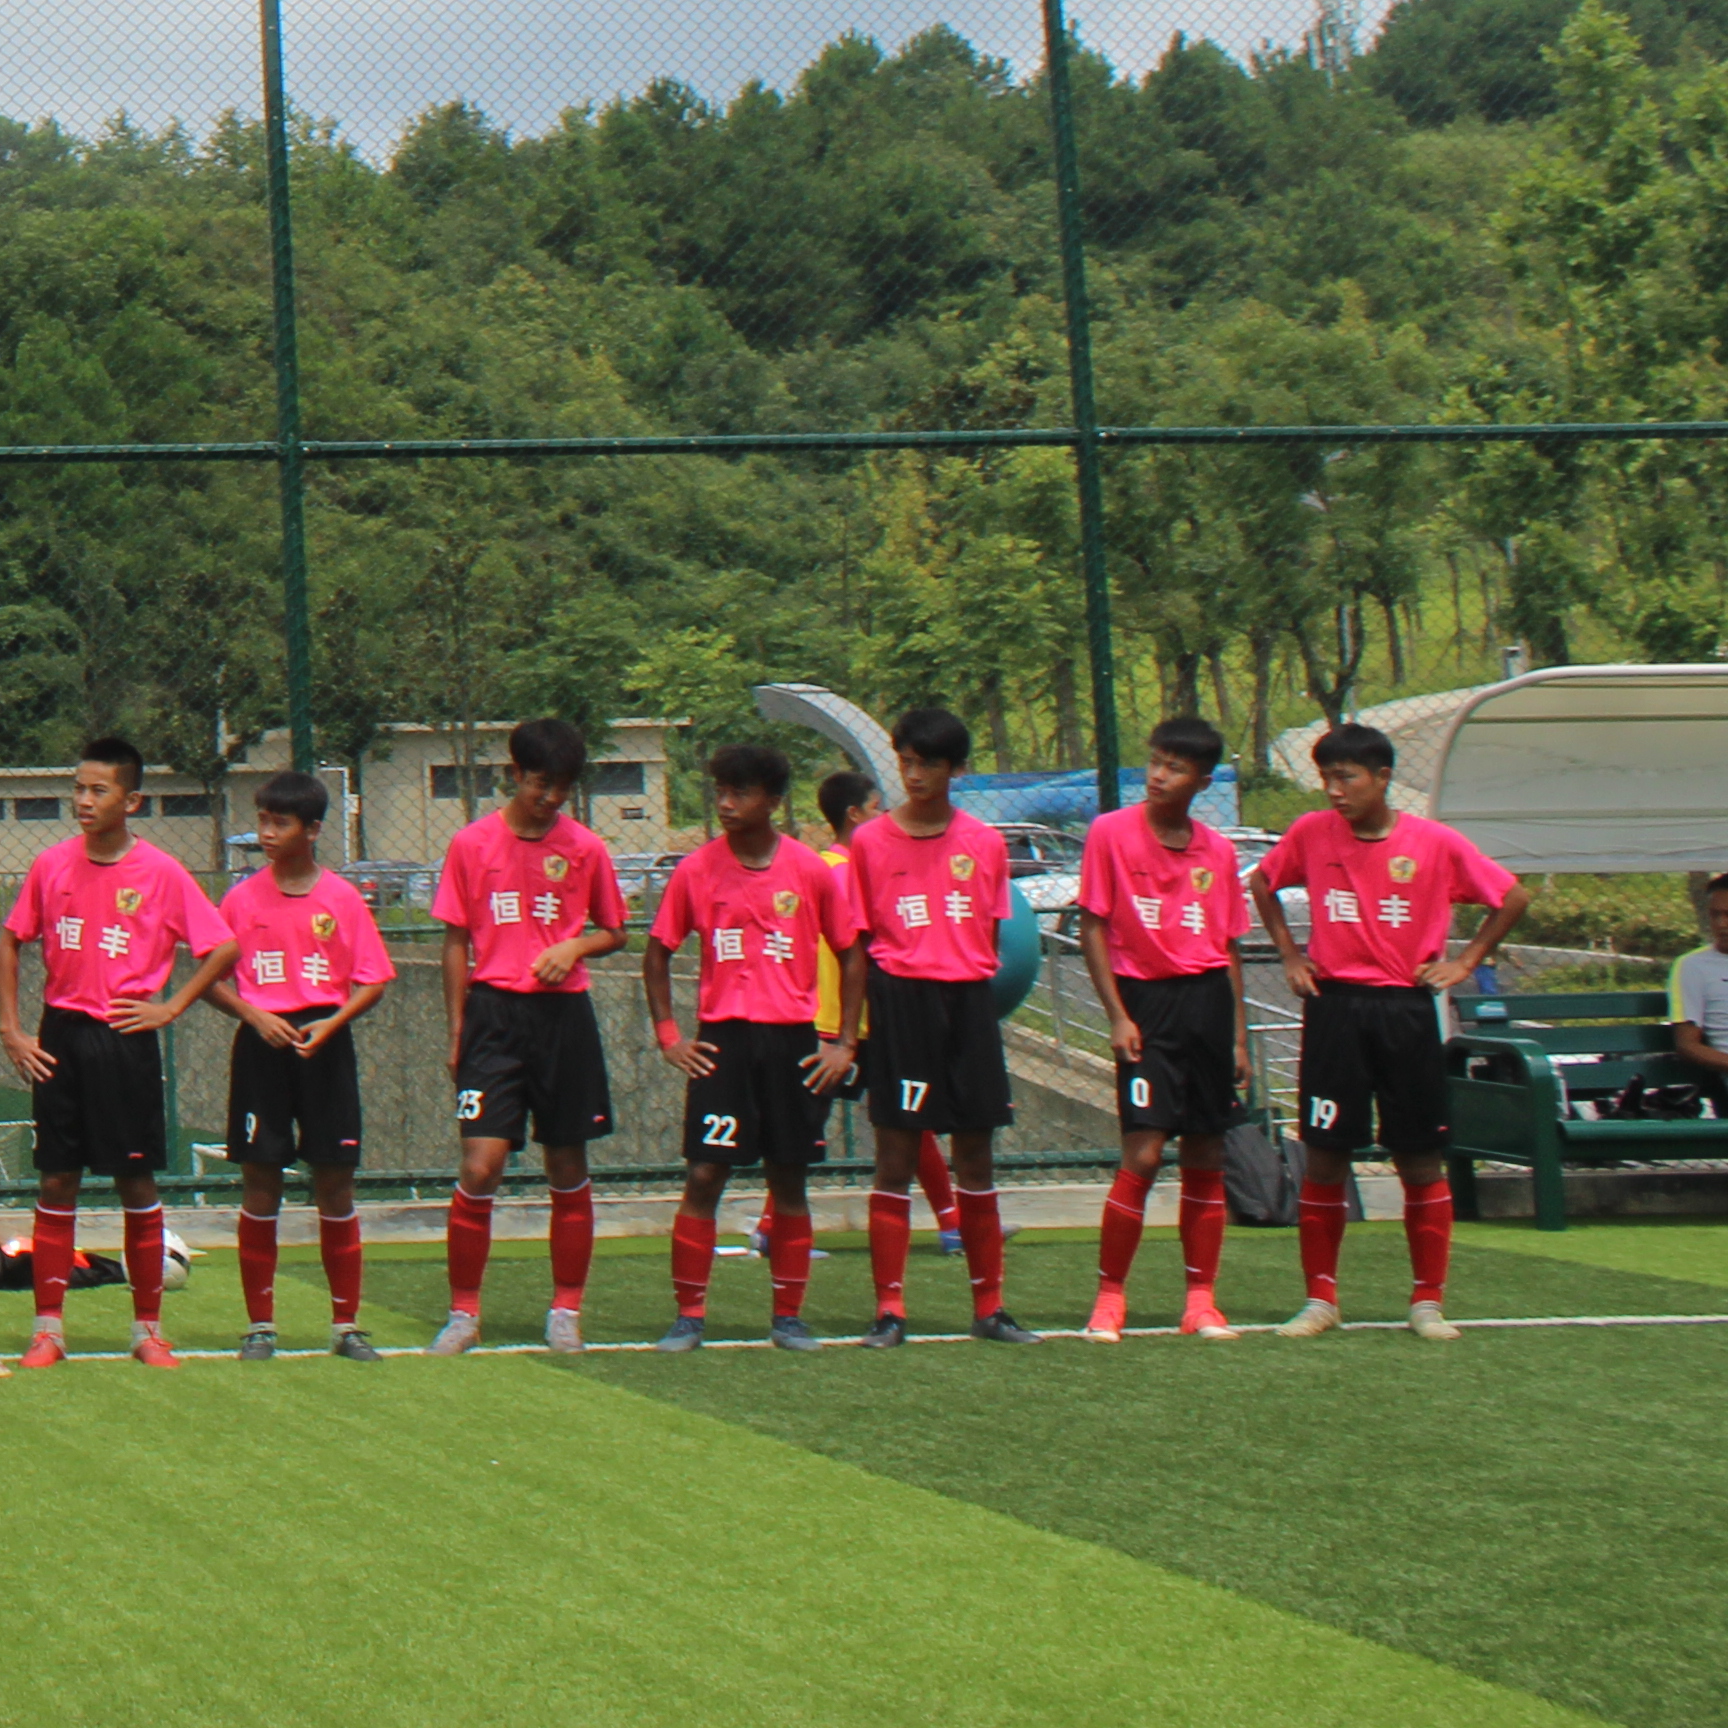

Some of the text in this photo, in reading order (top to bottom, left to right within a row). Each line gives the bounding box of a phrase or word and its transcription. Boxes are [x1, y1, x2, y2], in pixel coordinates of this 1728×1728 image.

[490, 891, 561, 925] 恒丰
[897, 890, 974, 929] 恒丰
[1133, 895, 1206, 935] 恒丰
[1325, 888, 1412, 928] 恒丰
[56, 916, 130, 958] 恒丰
[713, 928, 794, 964] 恒丰
[252, 951, 330, 986] 恒丰
[901, 1079, 929, 1112] 17
[1310, 1096, 1339, 1130] 19
[702, 1114, 737, 1148] 22
